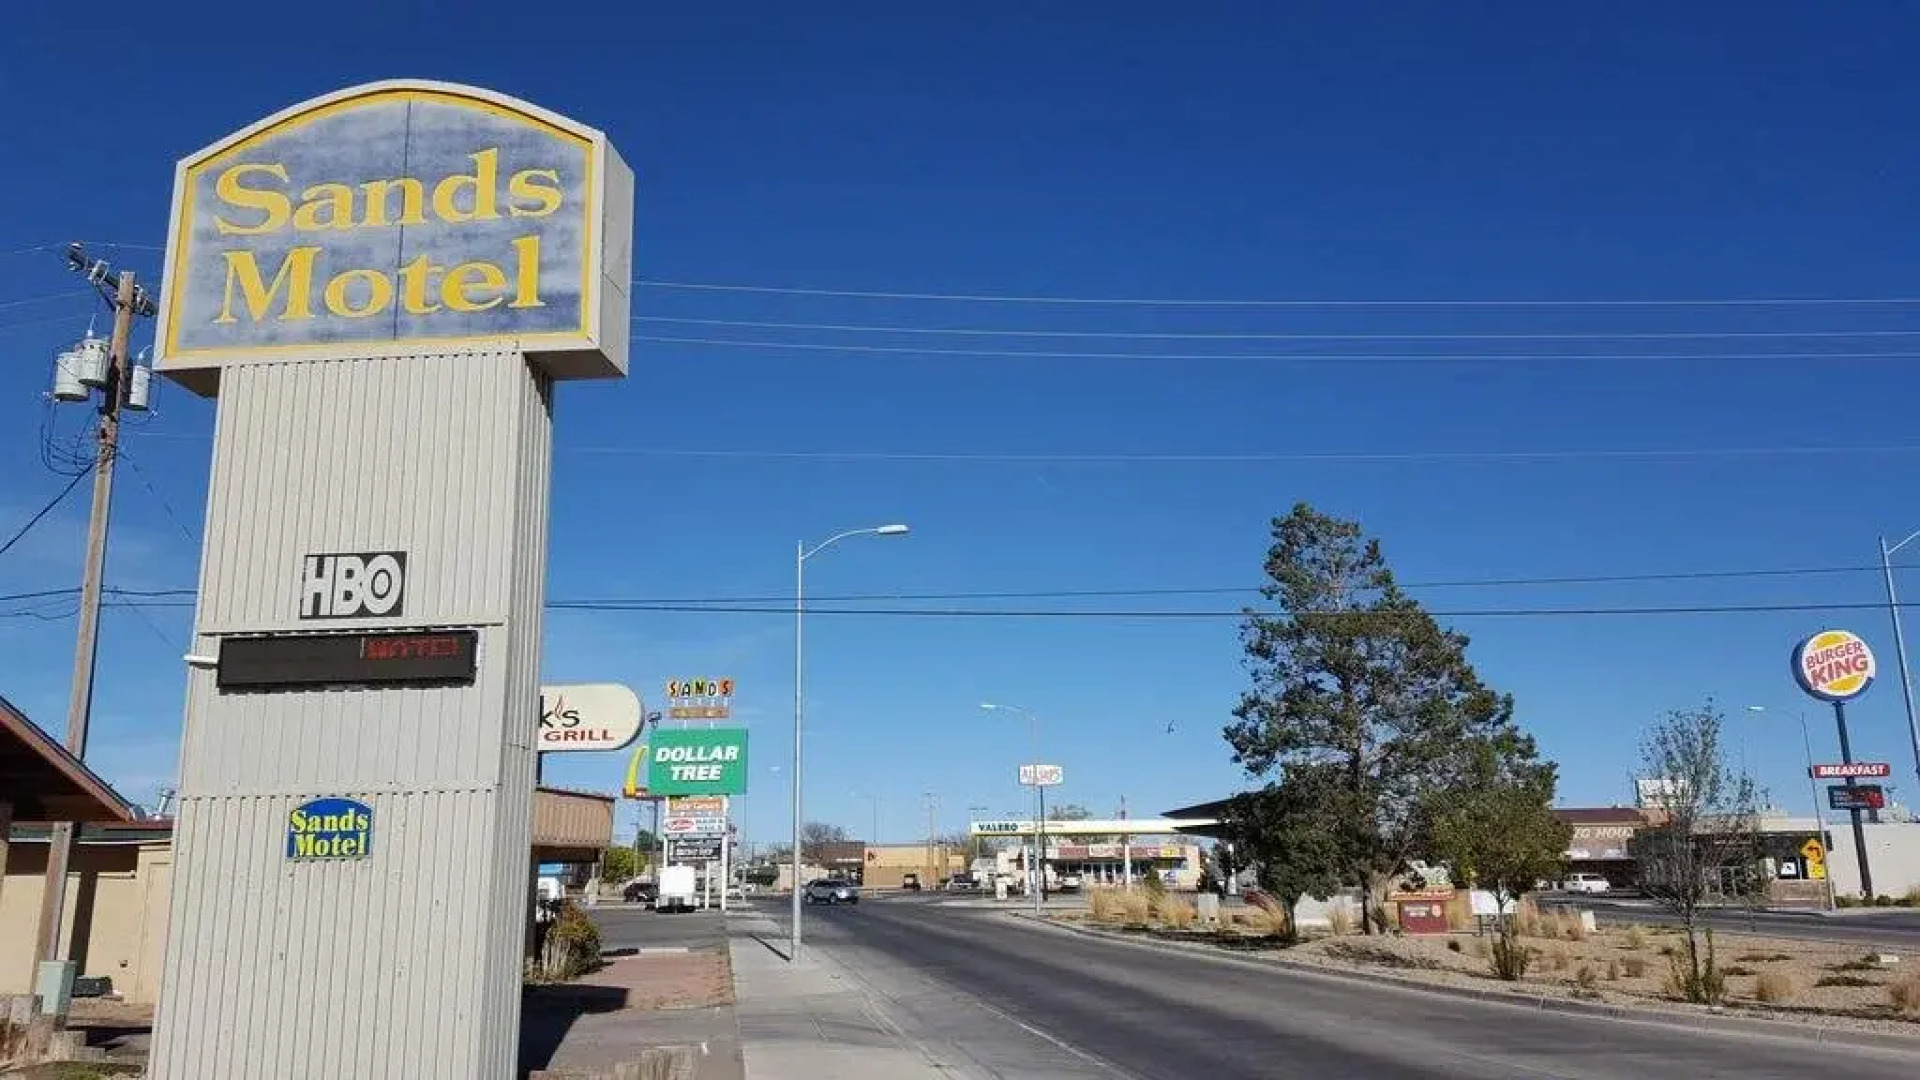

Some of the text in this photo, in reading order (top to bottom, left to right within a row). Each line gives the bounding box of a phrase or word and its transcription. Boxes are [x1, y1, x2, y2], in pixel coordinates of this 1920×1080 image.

[213, 147, 564, 236] Sands
[213, 235, 546, 324] Motel
[301, 554, 402, 616] HBO
[1805, 641, 1864, 669] BURGER
[1810, 653, 1869, 687] KING
[667, 680, 732, 697] SANDS
[543, 728, 616, 742] GRILL
[656, 745, 740, 762] DOLLAR
[670, 764, 723, 781] TREE
[1819, 764, 1885, 775] BREAKFAST
[290, 808, 369, 833] Sands
[293, 832, 367, 856] Motel
